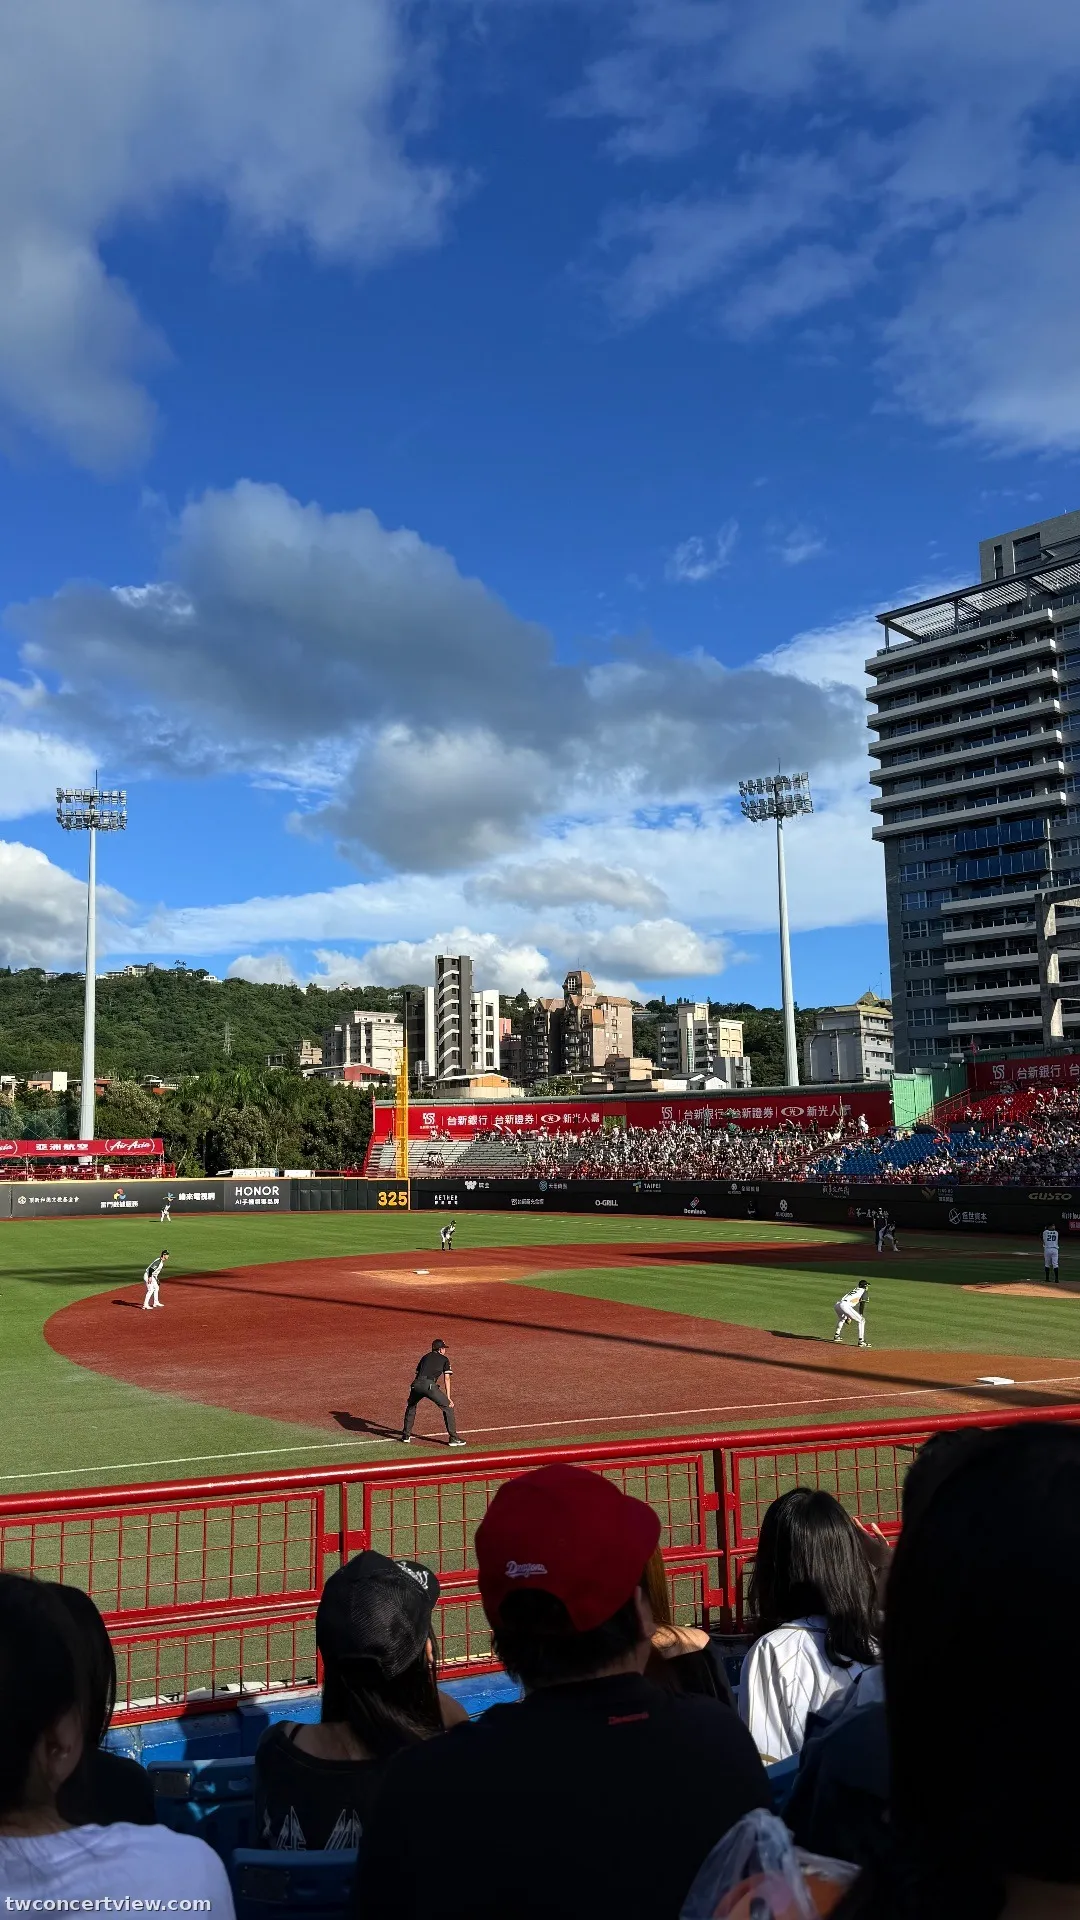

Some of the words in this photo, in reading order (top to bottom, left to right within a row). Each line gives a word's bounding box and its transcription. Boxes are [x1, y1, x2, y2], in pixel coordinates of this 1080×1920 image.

[1017, 1064, 1061, 1079] 台新銀行
[446, 1115, 487, 1126] 台新銀行
[494, 1114, 534, 1125] 台新證券
[36, 1143, 88, 1151] 亞洲航空
[235, 1186, 280, 1196] HONOR
[378, 1191, 408, 1206] 325
[505, 1560, 548, 1579] Dragons
